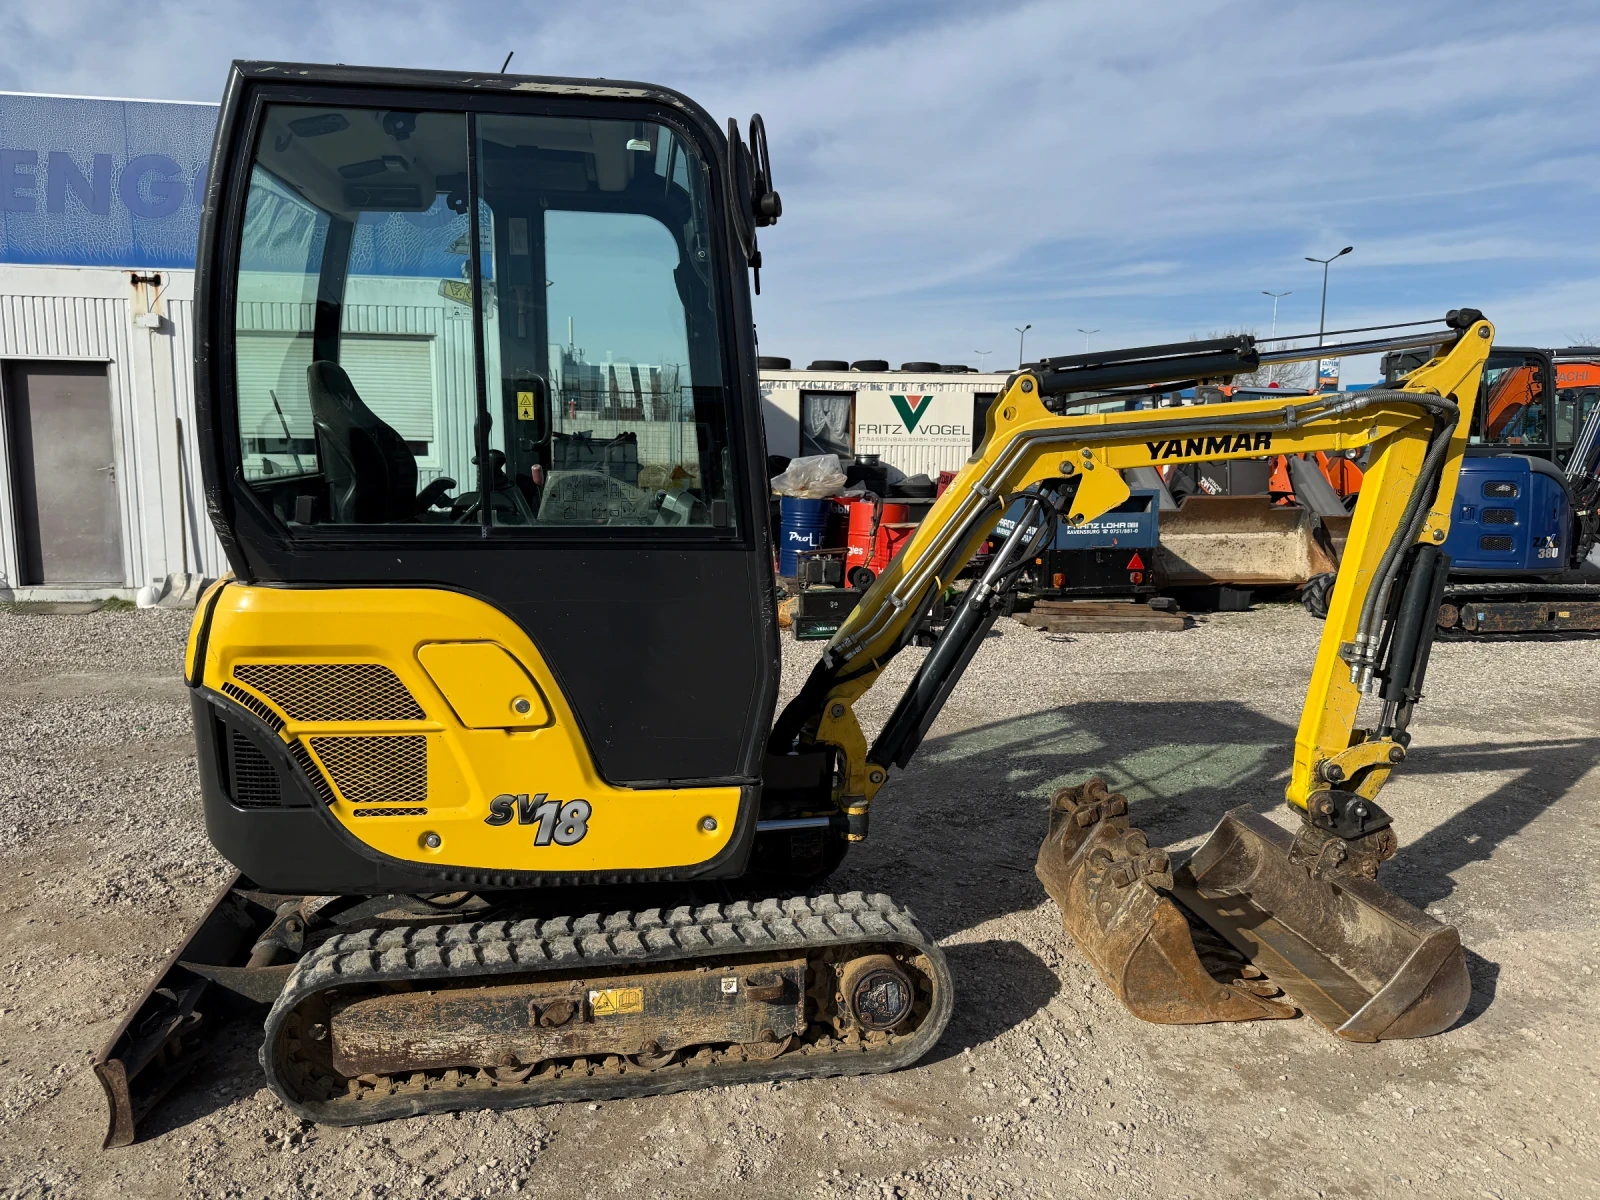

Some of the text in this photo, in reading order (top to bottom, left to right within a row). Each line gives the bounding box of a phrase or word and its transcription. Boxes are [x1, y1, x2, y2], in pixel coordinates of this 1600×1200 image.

[1556, 371, 1590, 382] ACHI
[858, 424, 971, 436] FRITZ VOGEL
[1145, 431, 1273, 461] YANMAR
[788, 531, 827, 547] ProLin
[1537, 547, 1559, 559] 38U
